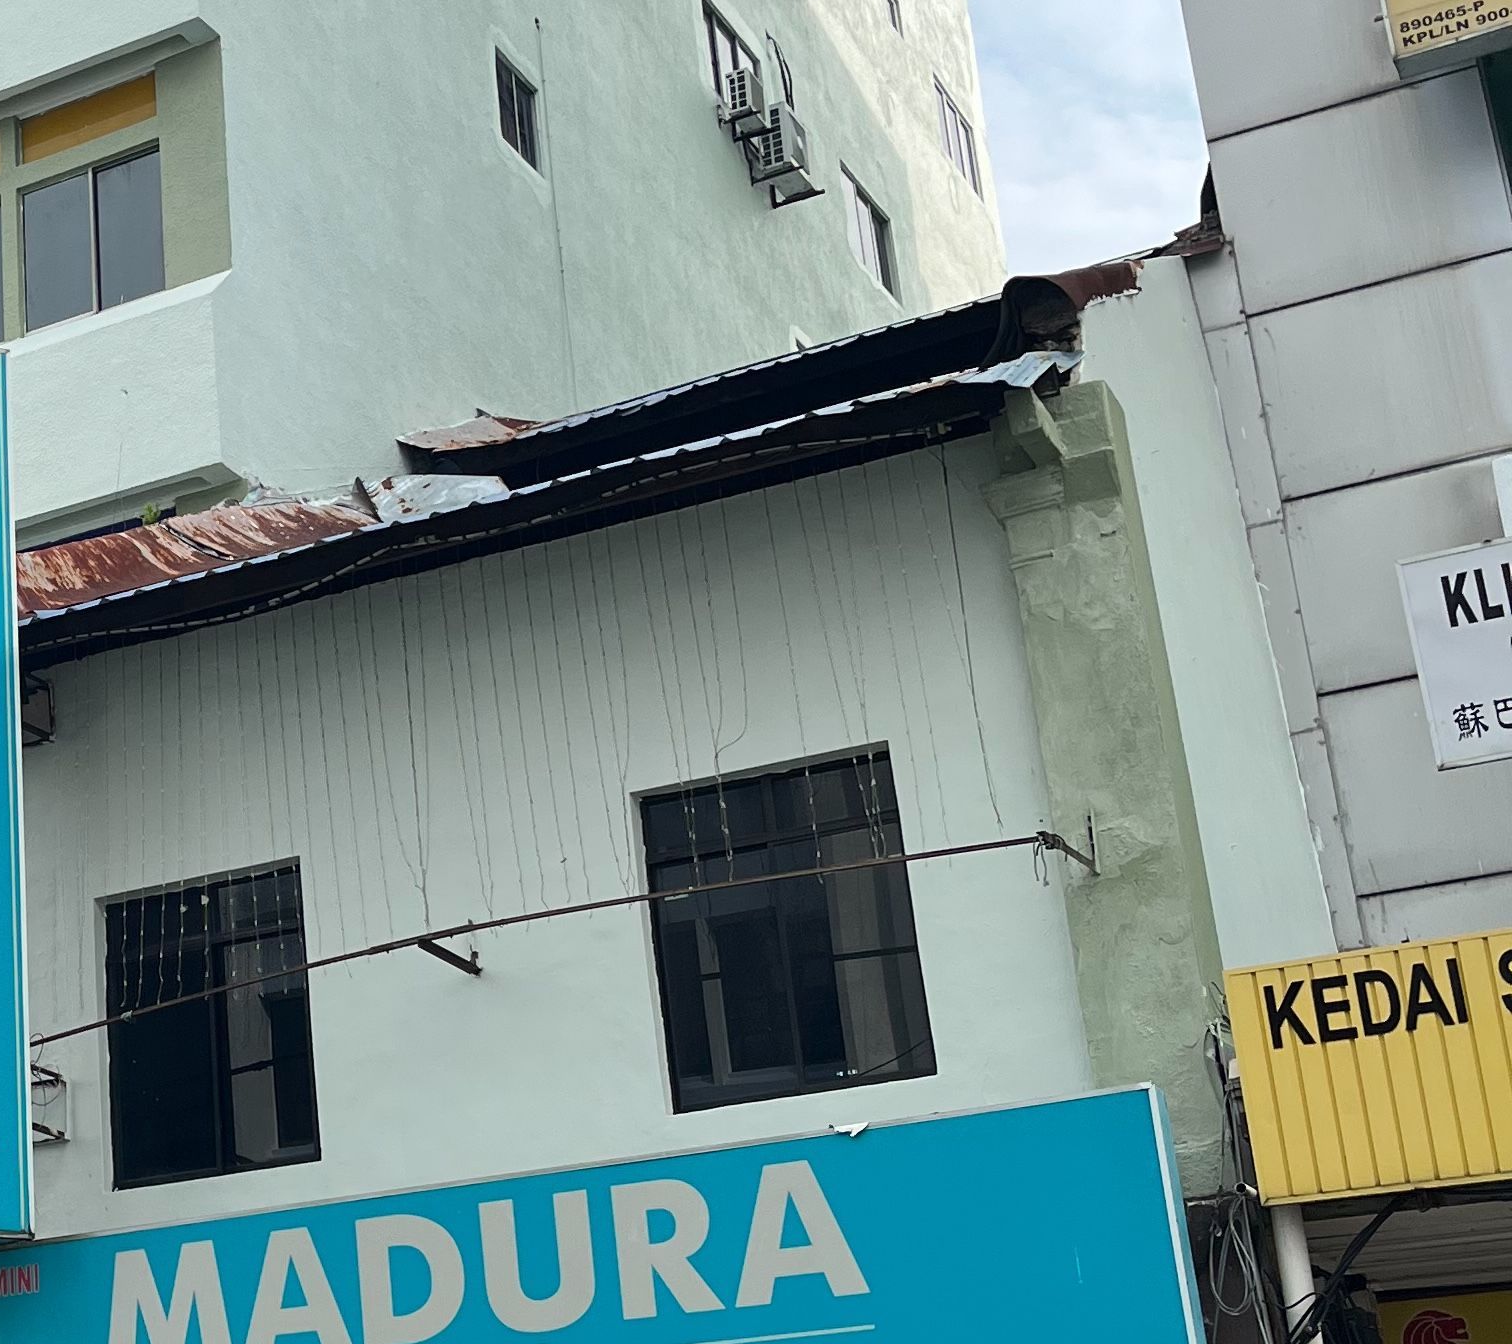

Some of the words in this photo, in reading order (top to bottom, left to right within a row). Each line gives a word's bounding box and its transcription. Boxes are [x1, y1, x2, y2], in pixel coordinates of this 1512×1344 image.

[1399, 0, 1485, 33] 890465-P
[1402, 18, 1469, 47] KPL/LN
[1263, 958, 1470, 1049] KEDAI
